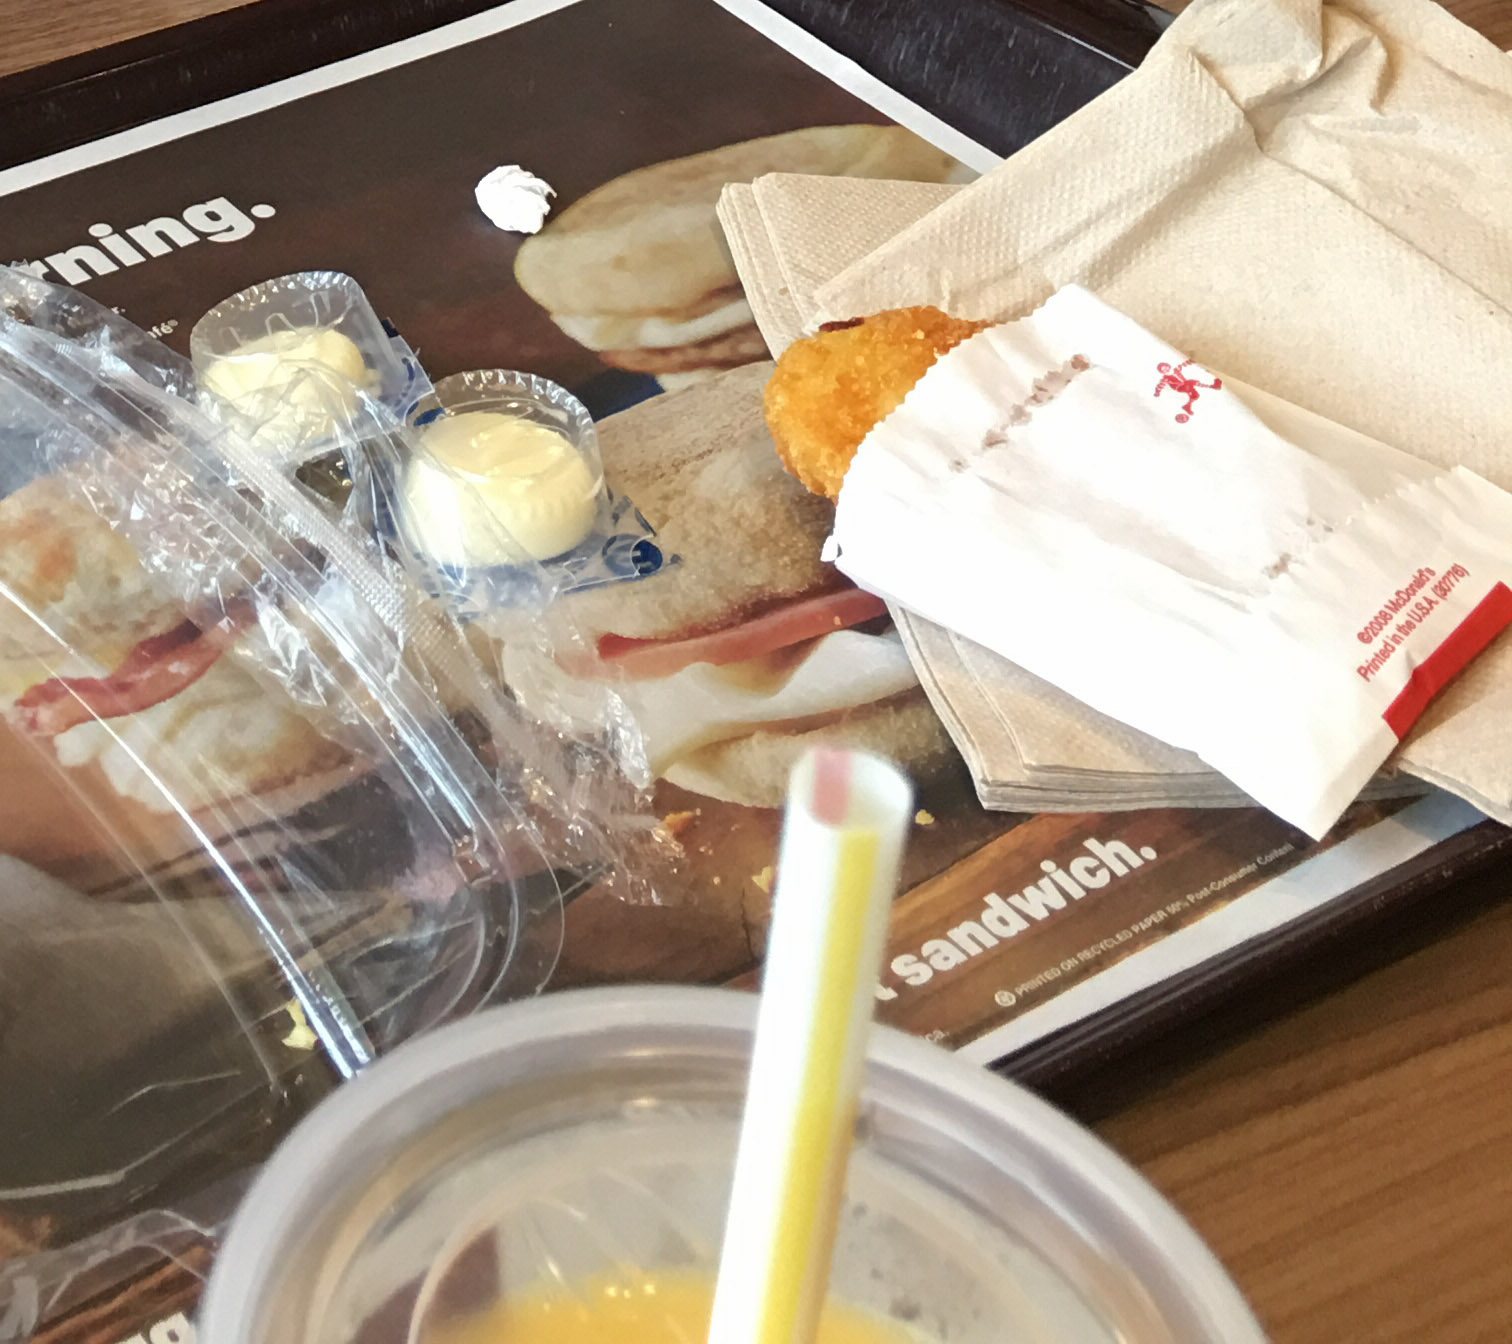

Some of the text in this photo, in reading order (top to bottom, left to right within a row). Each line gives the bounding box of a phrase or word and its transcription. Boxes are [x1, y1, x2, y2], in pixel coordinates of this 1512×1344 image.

[27, 195, 277, 287] rning.
[1386, 565, 1437, 615] McDonald's
[1356, 639, 1397, 683] Printed
[1388, 629, 1403, 646] in
[1397, 614, 1417, 636] the
[890, 837, 1159, 987] sandwich.
[1013, 966, 1063, 998] PRINTED
[1060, 955, 1079, 973] ON
[1076, 927, 1133, 964] RECYCLED
[1131, 909, 1168, 935] PAPER
[1256, 842, 1295, 866] Content
